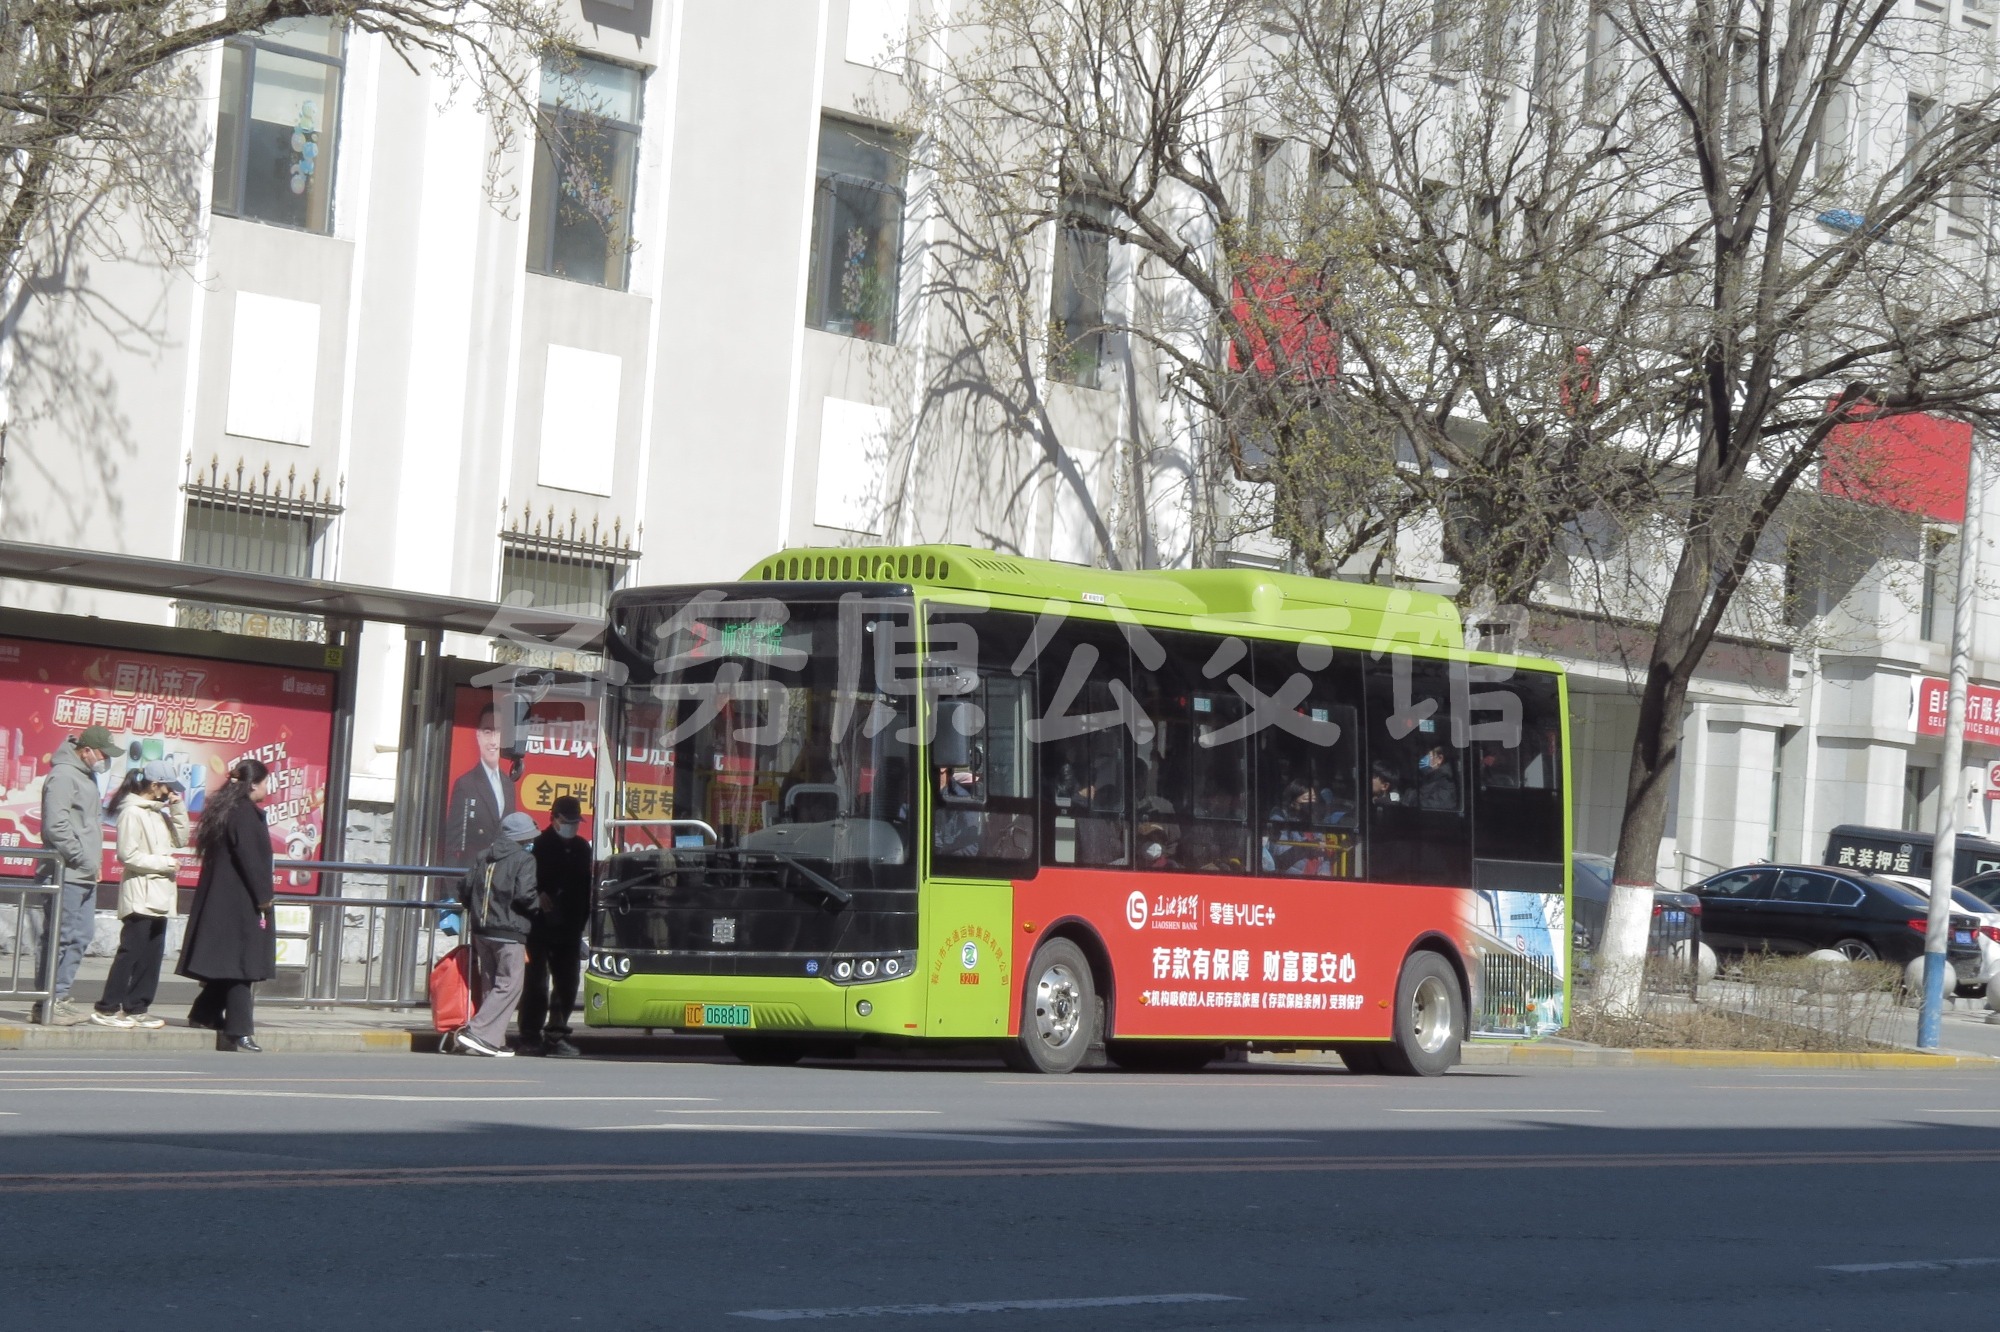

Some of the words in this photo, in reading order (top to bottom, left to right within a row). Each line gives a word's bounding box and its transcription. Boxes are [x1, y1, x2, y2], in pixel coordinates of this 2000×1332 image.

[691, 623, 708, 658] 2
[720, 622, 784, 657] 师范学院
[112, 661, 207, 705] 国补来了
[1928, 688, 2000, 724] 自行服
[1838, 847, 1911, 872] 武装押运
[1152, 920, 1181, 930] LIAOSHEN
[1182, 921, 1198, 931] BANK
[931, 924, 1009, 986] 鞍山市交通运输集团有限公司
[1152, 946, 1249, 981] 存款有保障
[1262, 950, 1356, 983] 财富更安心
[961, 973, 979, 984] 3207
